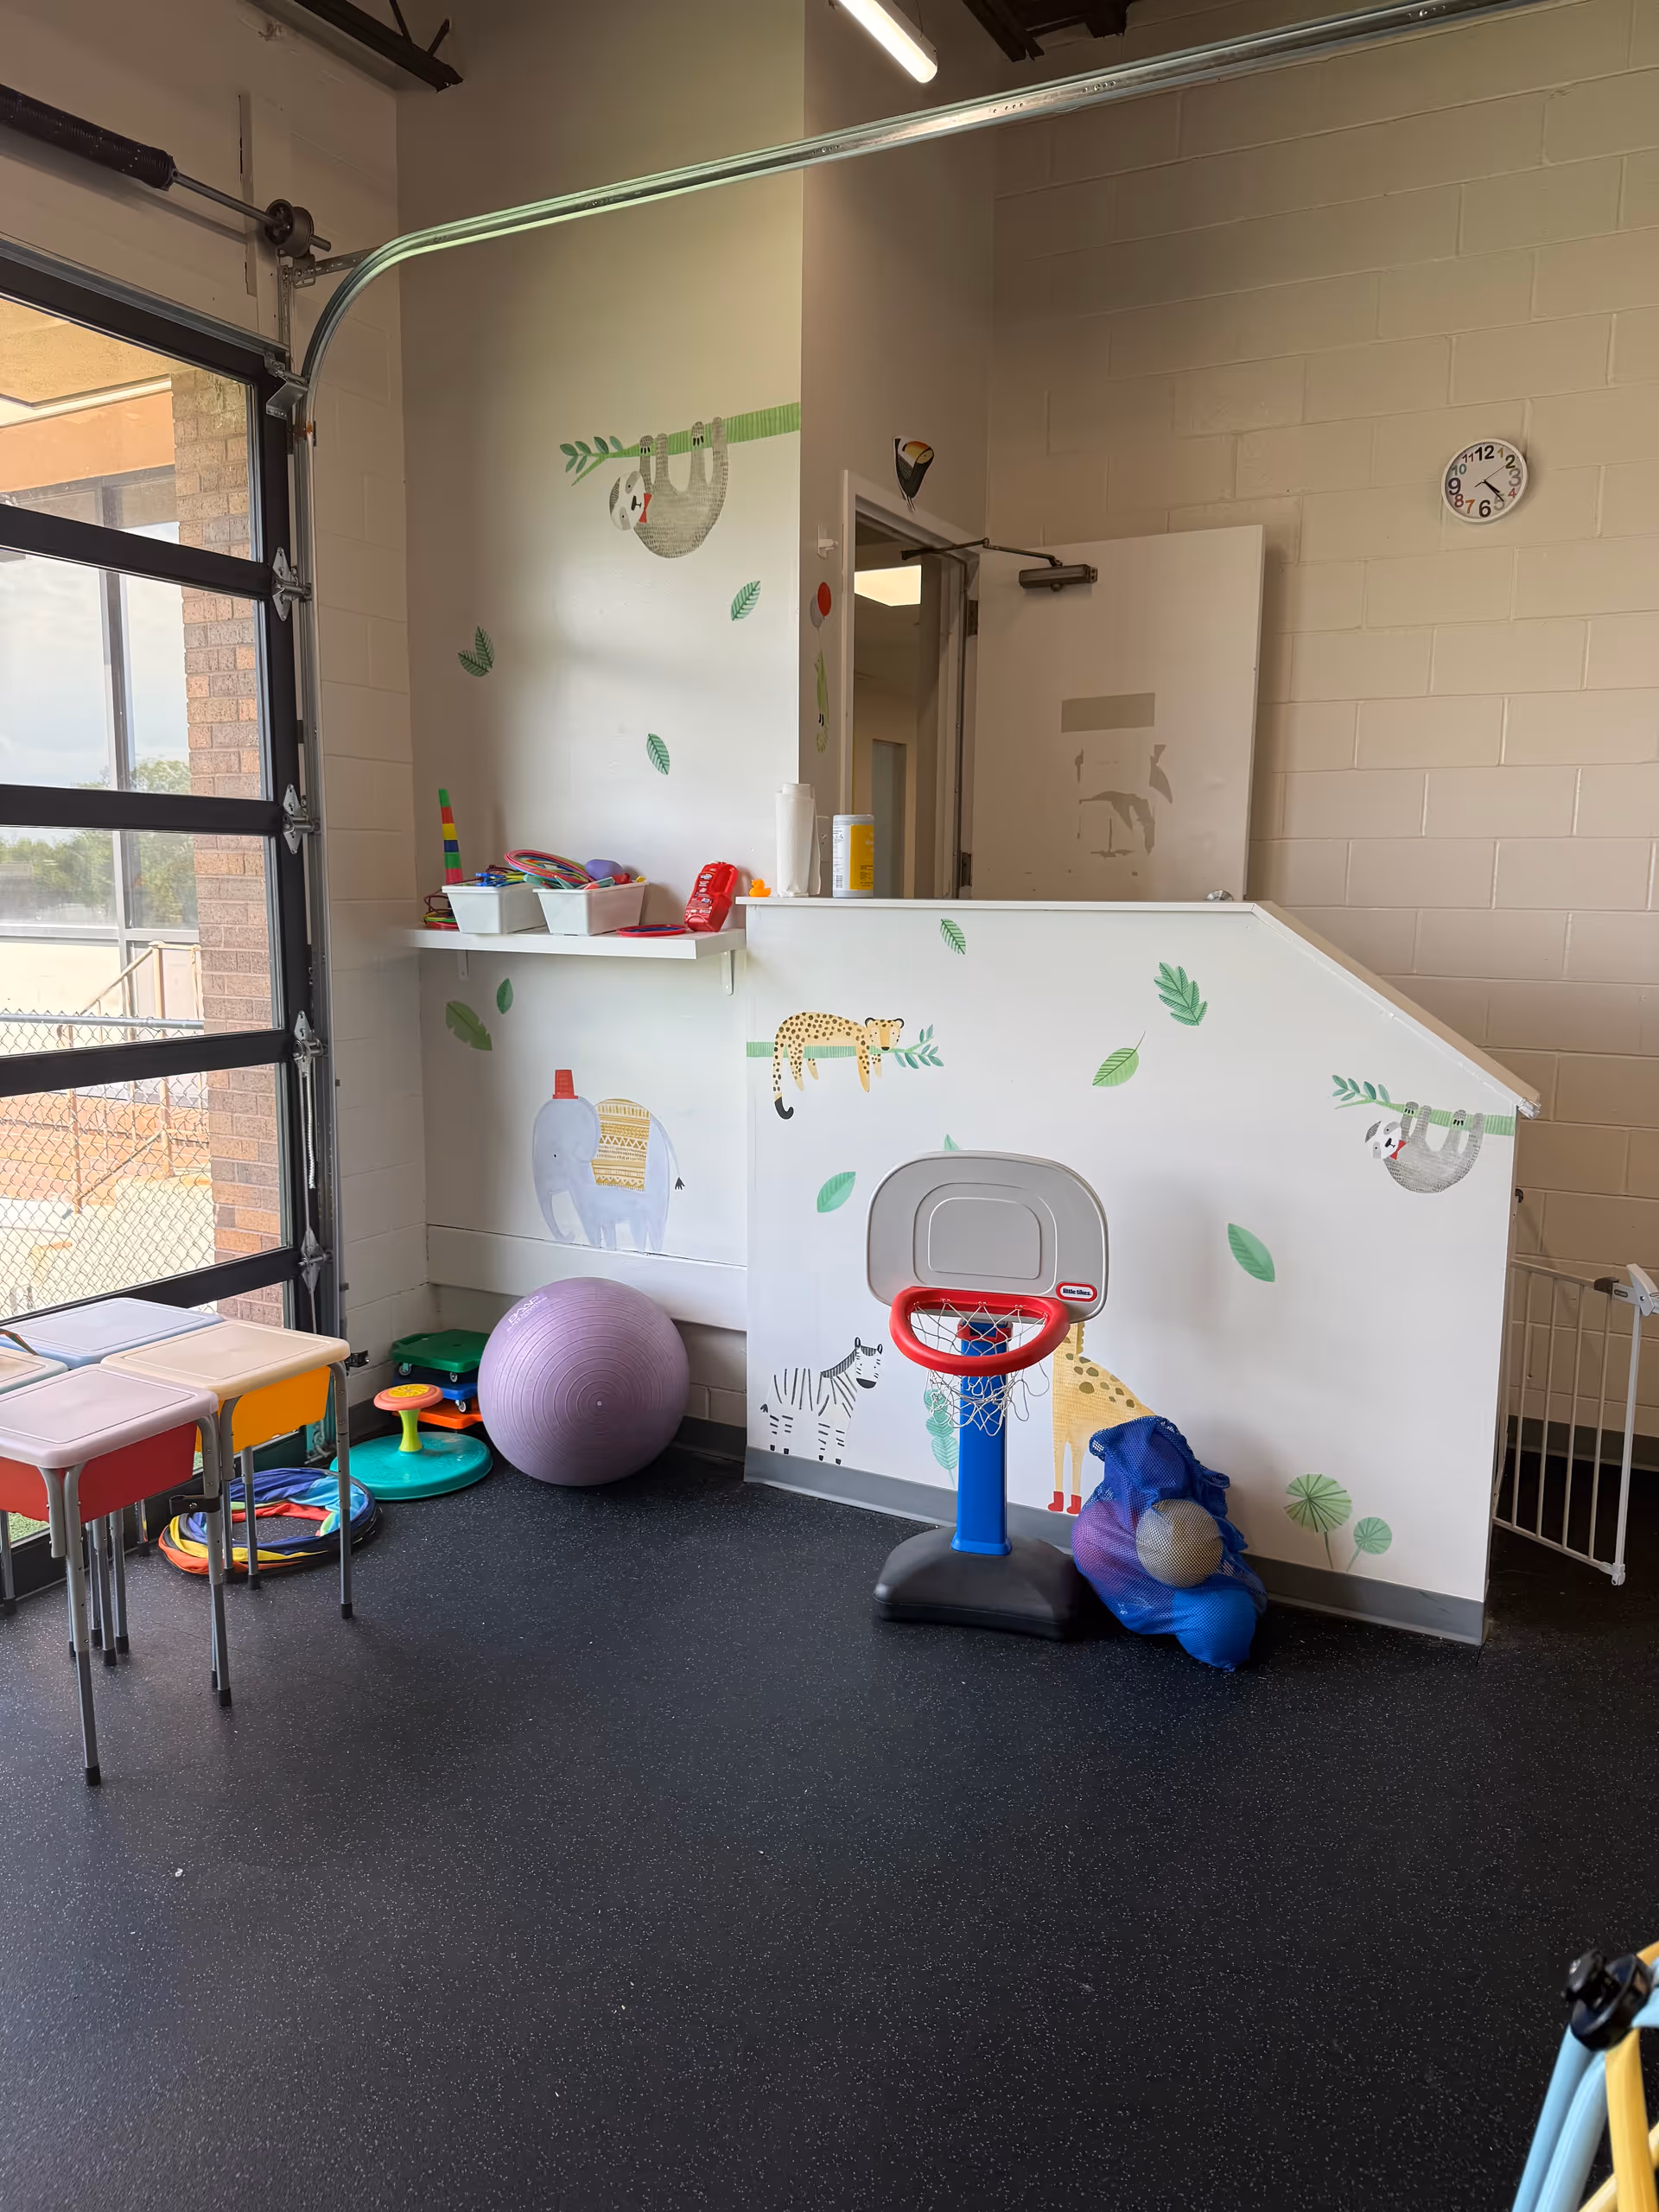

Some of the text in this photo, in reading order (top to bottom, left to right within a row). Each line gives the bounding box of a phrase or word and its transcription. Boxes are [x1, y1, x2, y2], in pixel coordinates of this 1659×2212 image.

[1462, 453, 1474, 463] 11
[1474, 445, 1495, 461] 12
[1497, 448, 1503, 459] 1
[1505, 454, 1516, 469] 2
[1452, 464, 1467, 476] 10
[1509, 468, 1522, 487] 3
[1448, 477, 1461, 495] 9
[1508, 488, 1516, 498] 4
[1454, 494, 1464, 507] 8
[1465, 499, 1475, 514] 7
[1493, 493, 1505, 512] 5
[1478, 499, 1491, 518] 6
